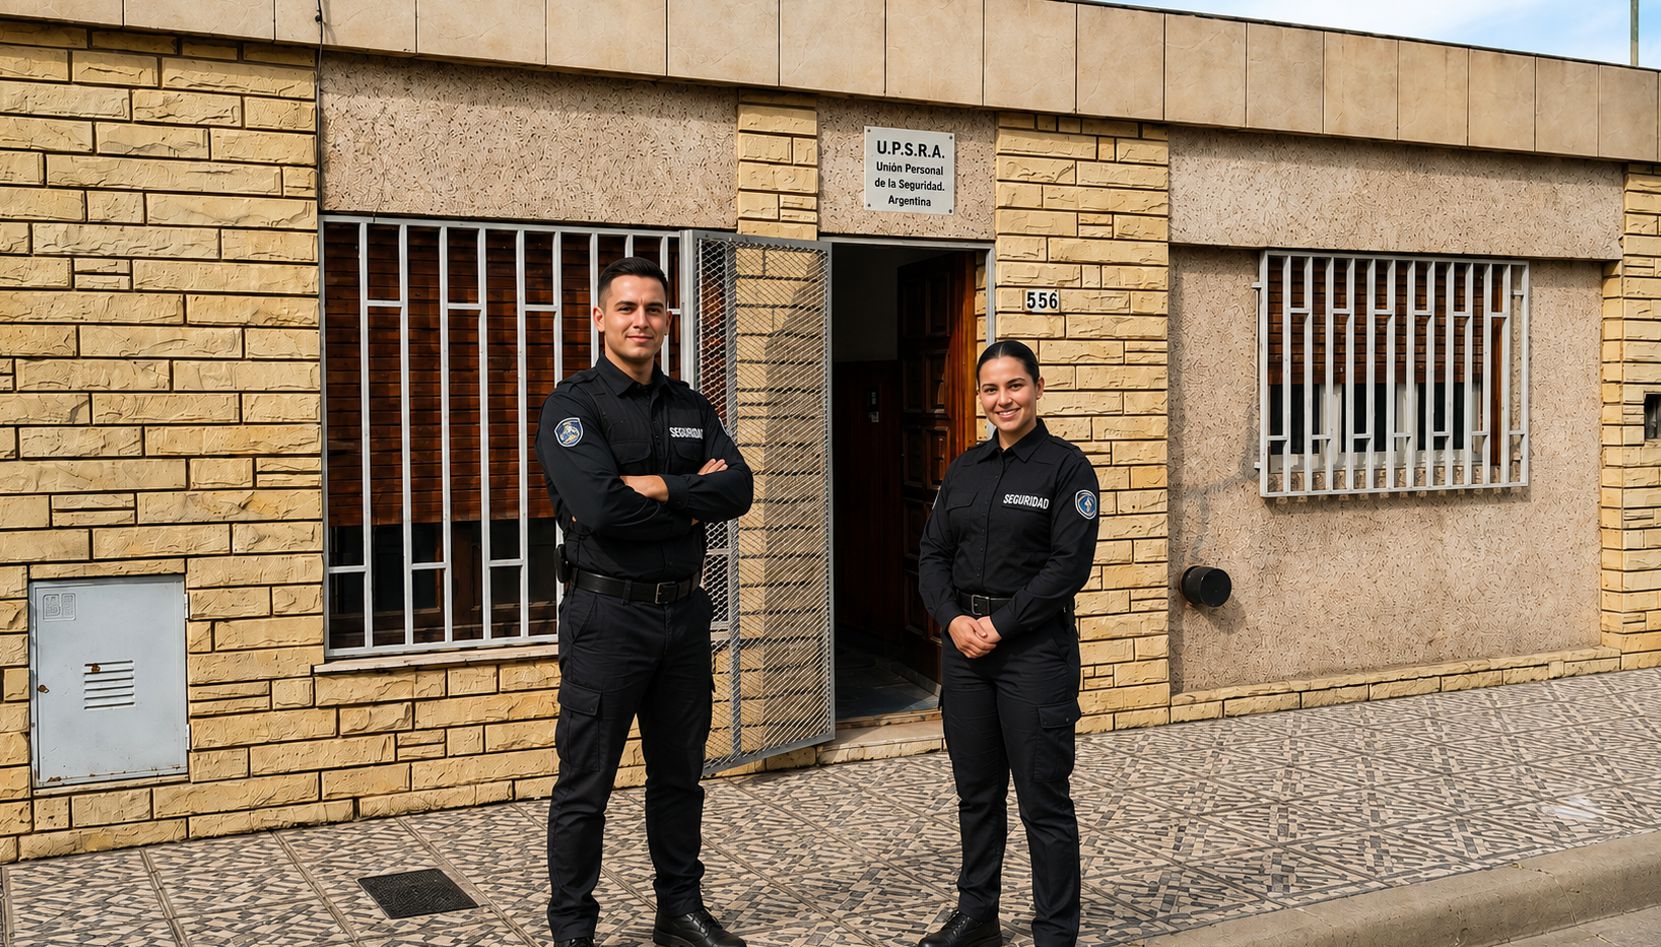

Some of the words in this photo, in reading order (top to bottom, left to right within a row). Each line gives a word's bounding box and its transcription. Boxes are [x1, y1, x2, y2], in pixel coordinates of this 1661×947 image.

[877, 140, 945, 159] U.P.S.R.A.
[876, 161, 903, 173] Unión
[905, 163, 944, 176] Personal
[874, 177, 886, 188] de
[888, 178, 896, 189] la
[898, 179, 945, 192] Seguridad.
[888, 195, 932, 207] Argentina
[1027, 291, 1058, 309] 556
[1003, 493, 1050, 510] SEGURIDAD
